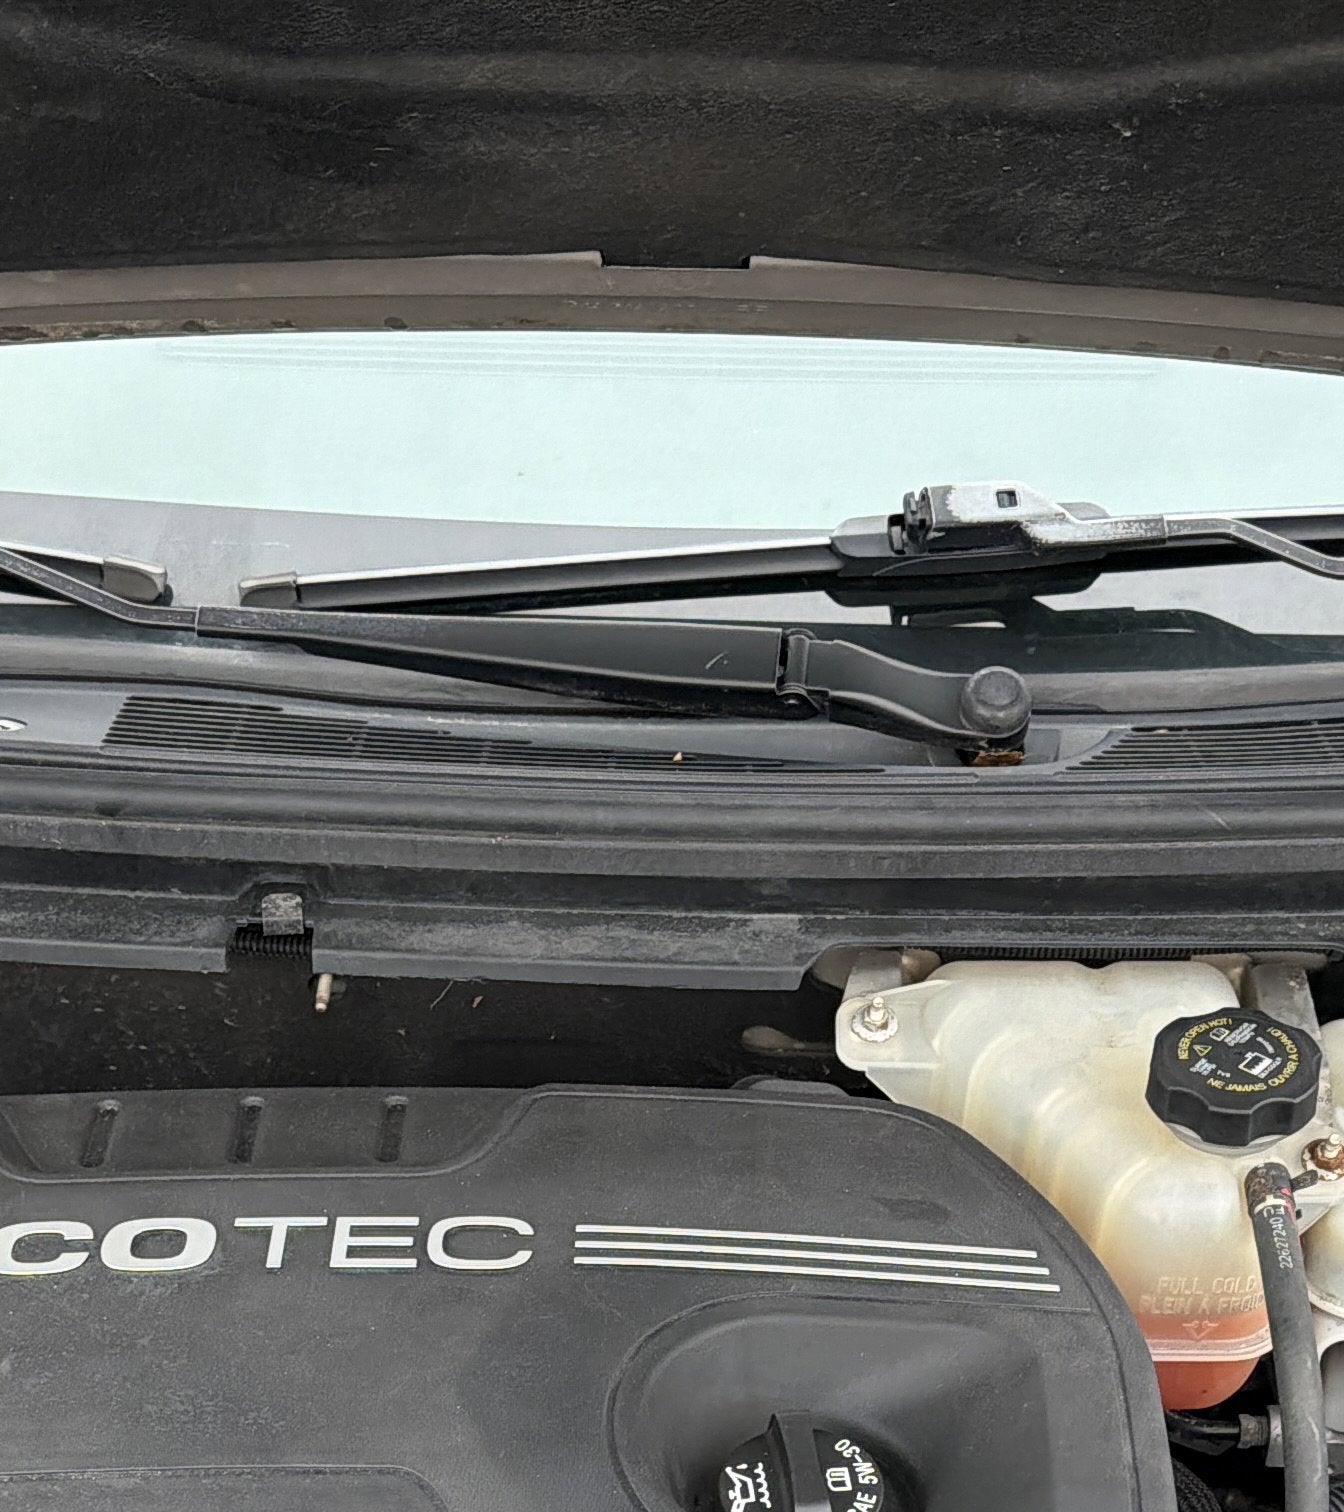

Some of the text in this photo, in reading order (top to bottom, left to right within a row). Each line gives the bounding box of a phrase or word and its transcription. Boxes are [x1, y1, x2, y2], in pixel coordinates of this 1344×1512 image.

[1177, 1033, 1192, 1061] NEVER
[1187, 1022, 1210, 1040] OPEN
[1208, 1018, 1228, 1028] HOT
[1206, 1077, 1224, 1089] NE
[1225, 1082, 1267, 1092] JAMAIS
[1157, 1275, 1257, 1295] FULL COLD
[1139, 1295, 1191, 1314] PLEIN
[834, 1438, 879, 1485] 5W-30
